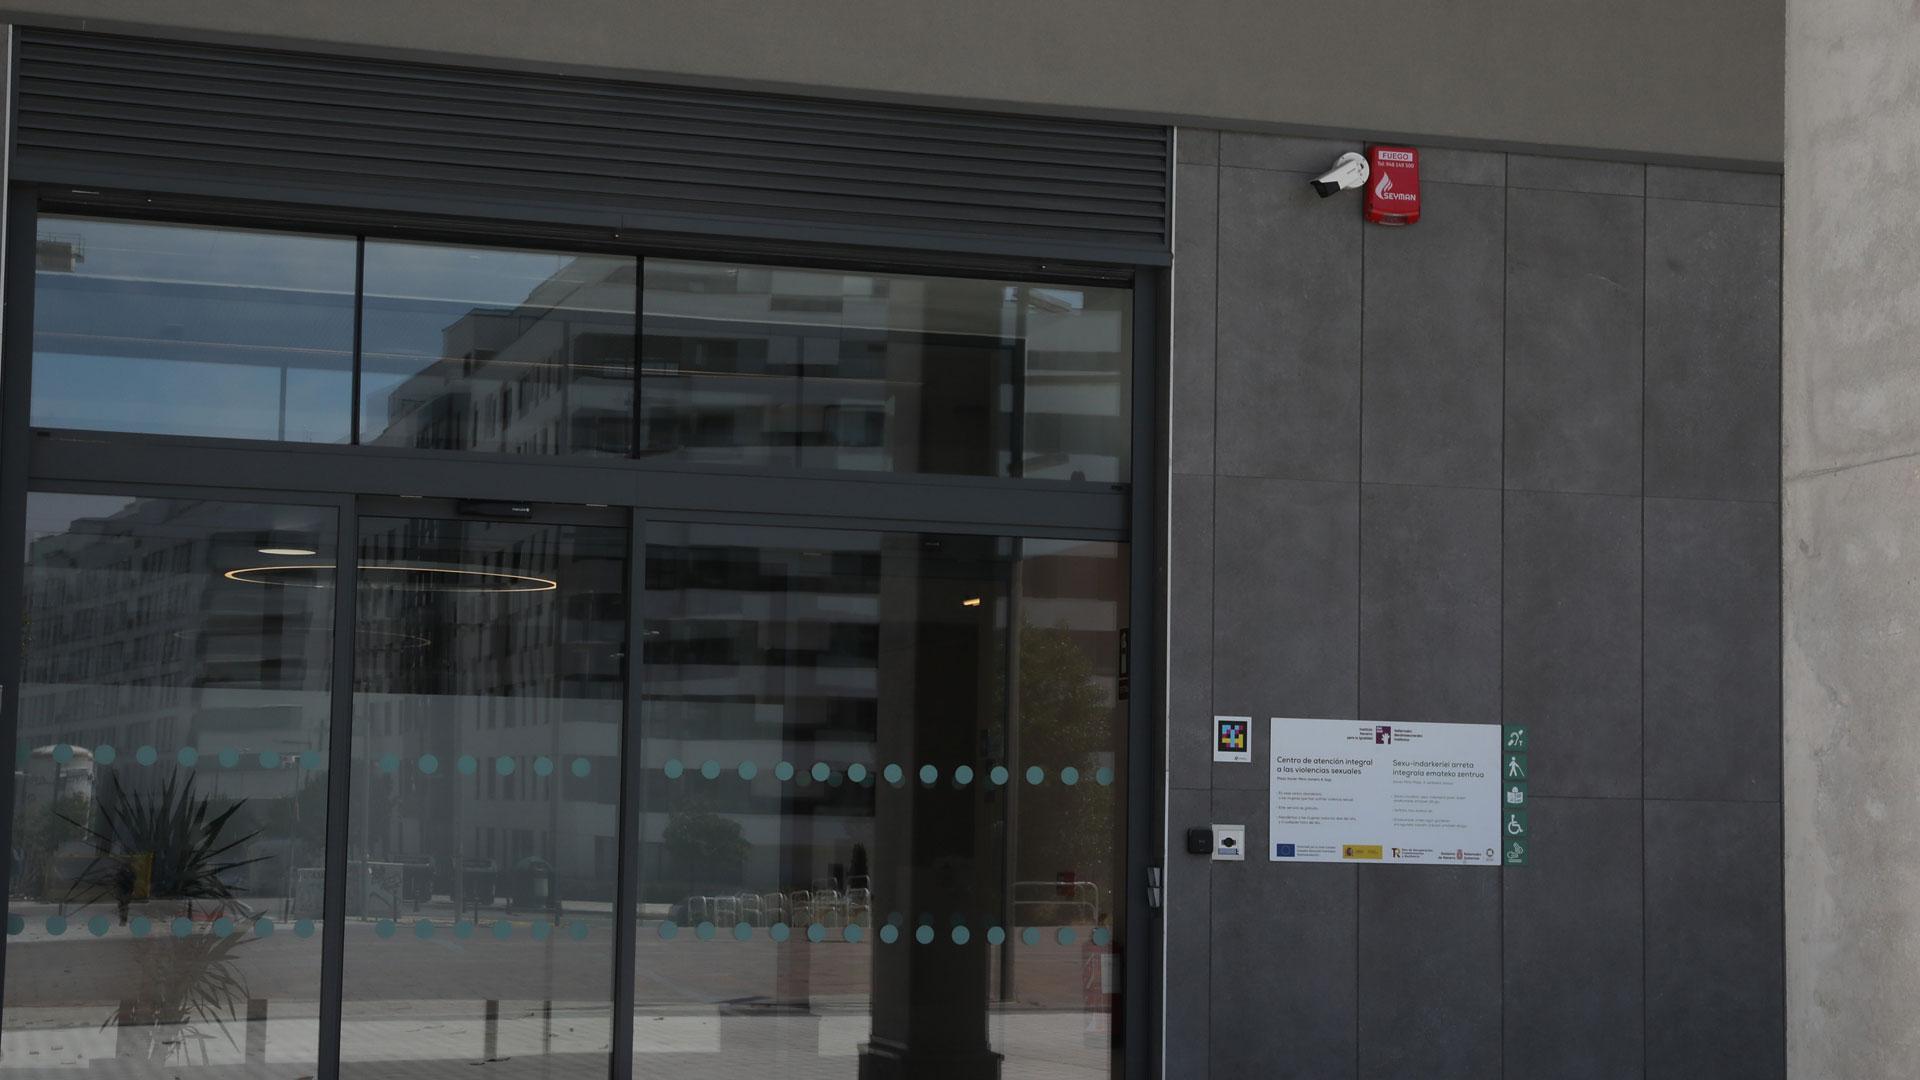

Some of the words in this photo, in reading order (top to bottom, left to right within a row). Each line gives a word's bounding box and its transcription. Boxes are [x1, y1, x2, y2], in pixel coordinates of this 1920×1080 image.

[1382, 152, 1409, 160] FUEGO
[1383, 192, 1417, 201] SEYMAN
[1276, 756, 1301, 764] Centro
[1313, 757, 1344, 765] atención
[1345, 758, 1373, 767] integral
[1392, 759, 1450, 768] Sexu-indarkeriei
[1295, 766, 1330, 774] violencias
[1331, 767, 1362, 775] sexuales
[1392, 769, 1425, 778] integrala
